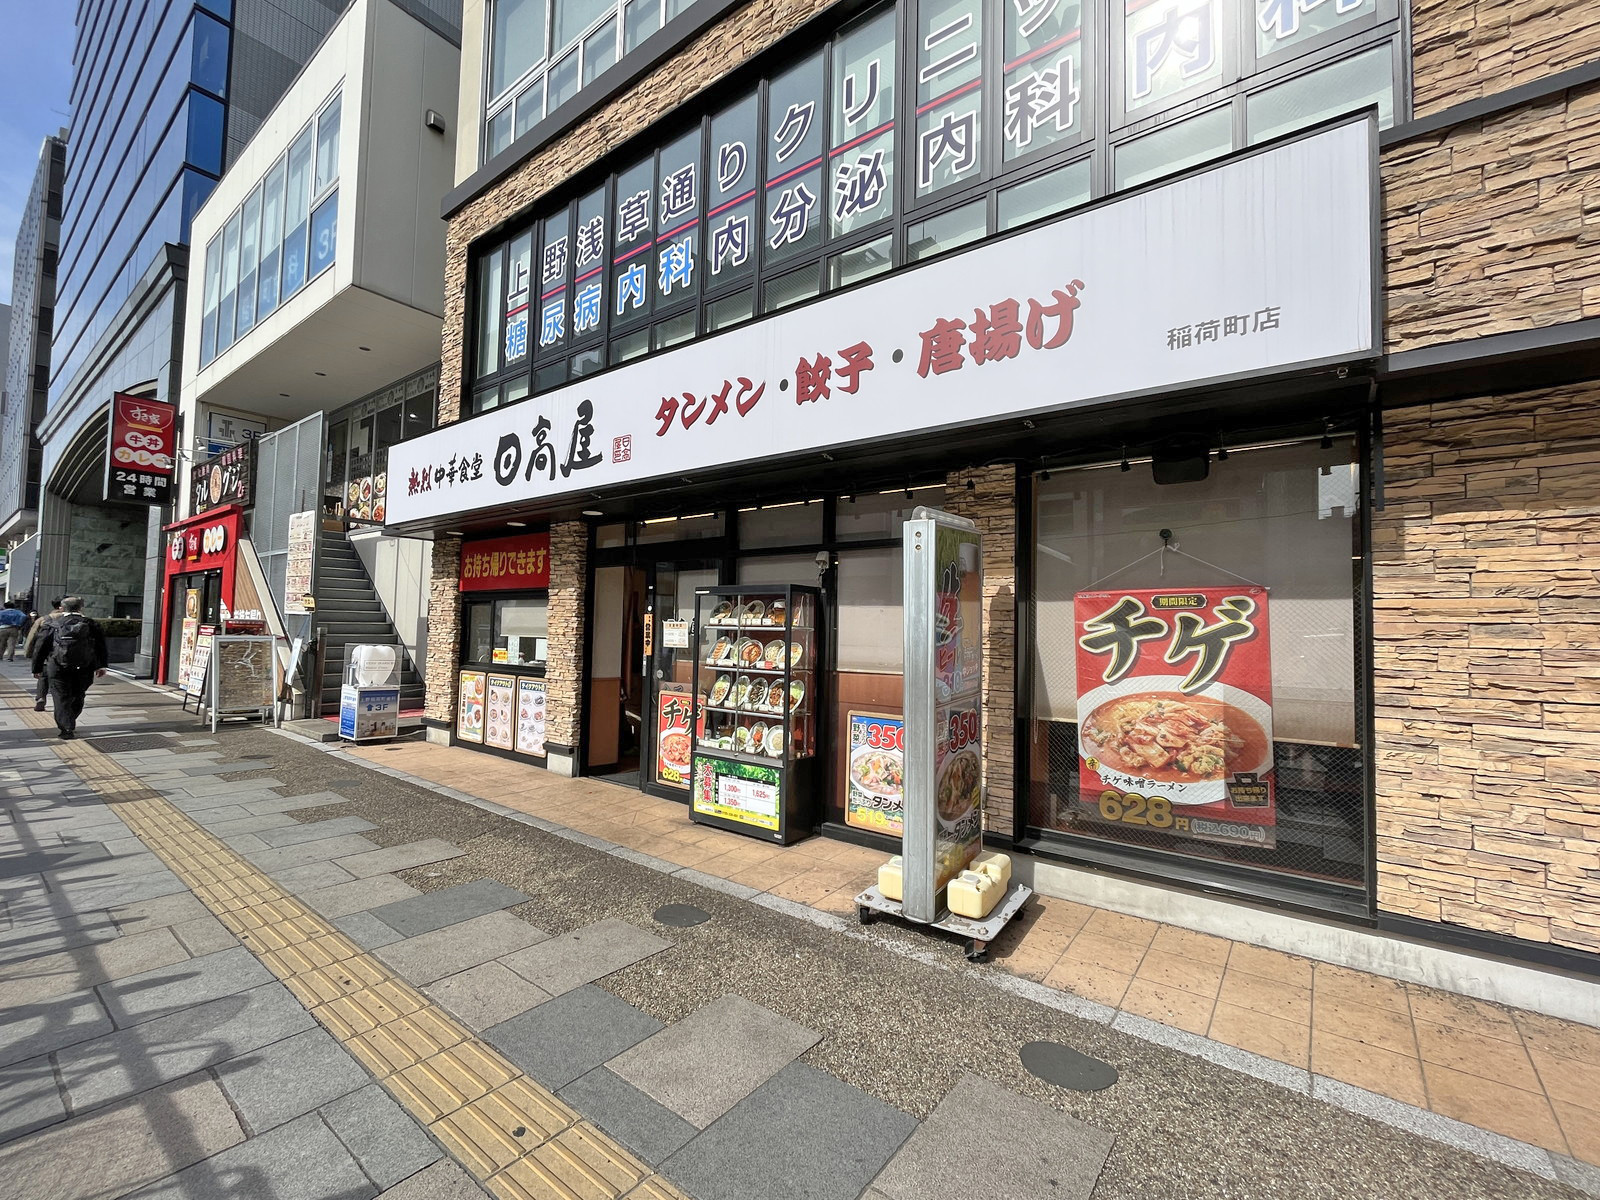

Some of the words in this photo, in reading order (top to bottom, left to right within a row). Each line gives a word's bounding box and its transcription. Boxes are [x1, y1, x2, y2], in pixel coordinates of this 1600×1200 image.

[505, 236, 694, 361] 糖尿病内科
[711, 54, 1080, 275] 内分泌内科
[1166, 306, 1281, 351] 稲荷町店
[129, 406, 160, 425] すき家
[129, 434, 160, 448] 牛丼
[493, 399, 603, 487] 日高屋
[118, 449, 168, 463] カレー
[115, 471, 167, 488] 24時間
[123, 484, 157, 498] 営業
[463, 547, 547, 578] お持ち帰りできます
[1079, 596, 1255, 693] チゲ
[375, 703, 389, 712] 3F
[949, 708, 978, 752] 350
[1101, 774, 1188, 793] チゲ味噌ラーメン
